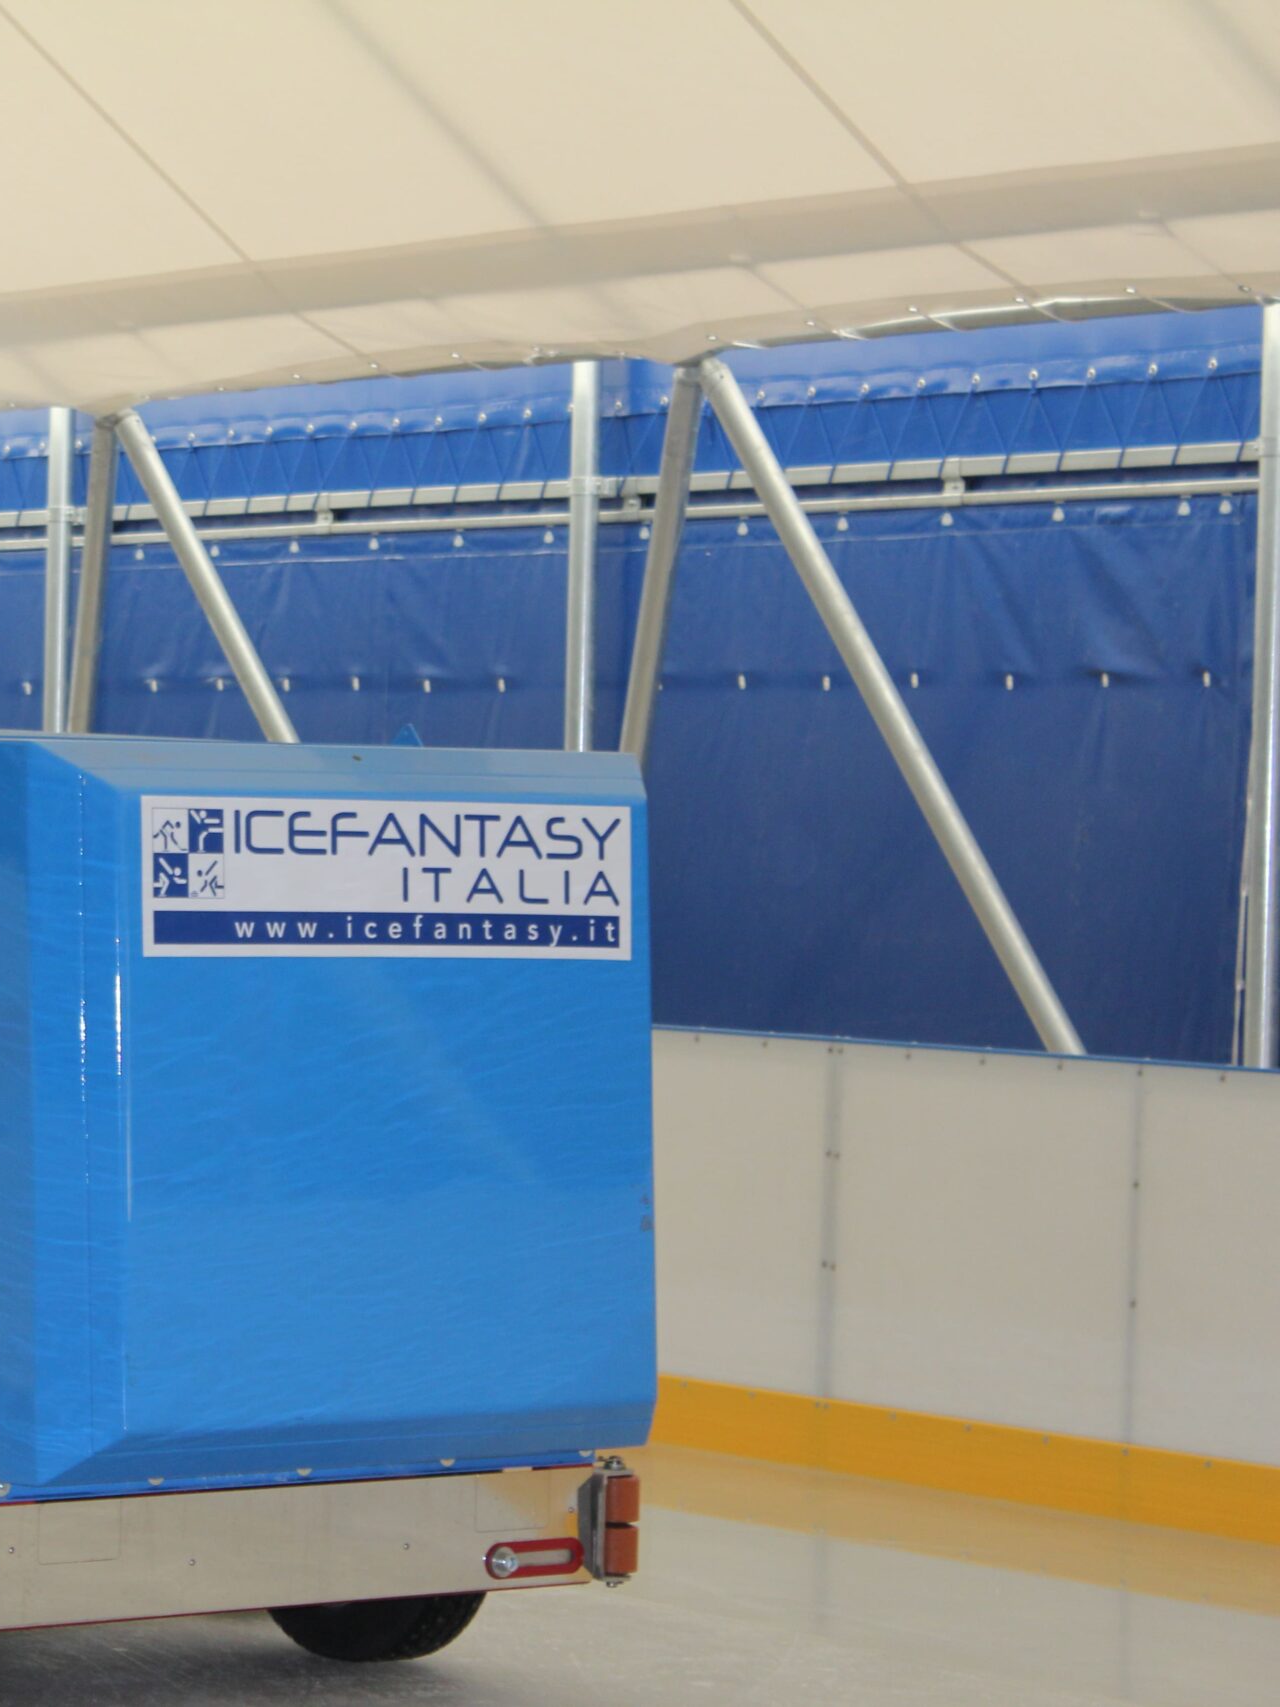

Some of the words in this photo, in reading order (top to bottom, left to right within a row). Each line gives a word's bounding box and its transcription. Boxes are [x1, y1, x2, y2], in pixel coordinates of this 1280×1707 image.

[234, 809, 621, 861] ICEFANTASY
[402, 867, 620, 906] ITALIA
[235, 915, 616, 947] www.icefantasy.it
